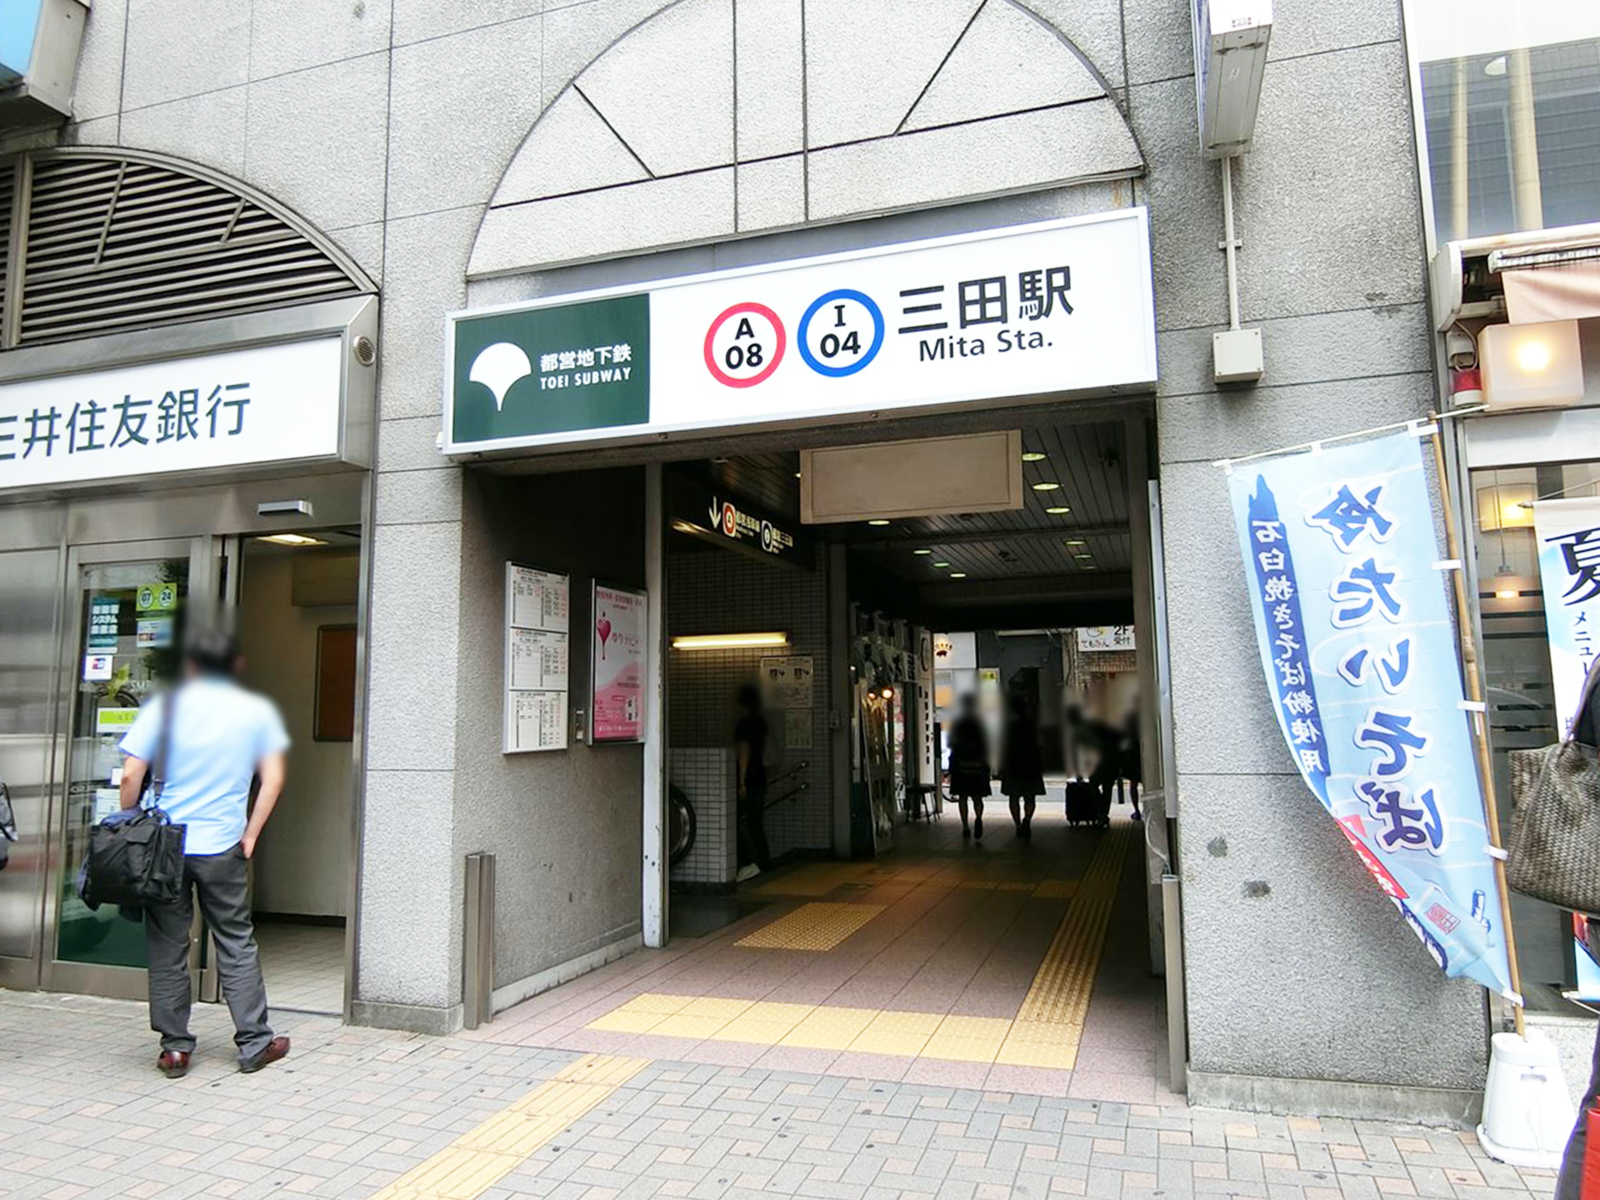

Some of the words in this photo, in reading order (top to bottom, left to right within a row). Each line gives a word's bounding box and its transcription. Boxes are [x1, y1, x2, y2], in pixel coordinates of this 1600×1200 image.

[898, 265, 1074, 334] 三田駅
[735, 318, 755, 340] A
[834, 304, 846, 327] I
[540, 343, 632, 372] 都営地下鉄
[725, 343, 763, 370] 08
[820, 331, 861, 358] 04
[920, 336, 985, 362] Mita
[997, 329, 1053, 352] Sta.
[540, 374, 569, 390] TOEI
[574, 366, 631, 386] SUBWAY
